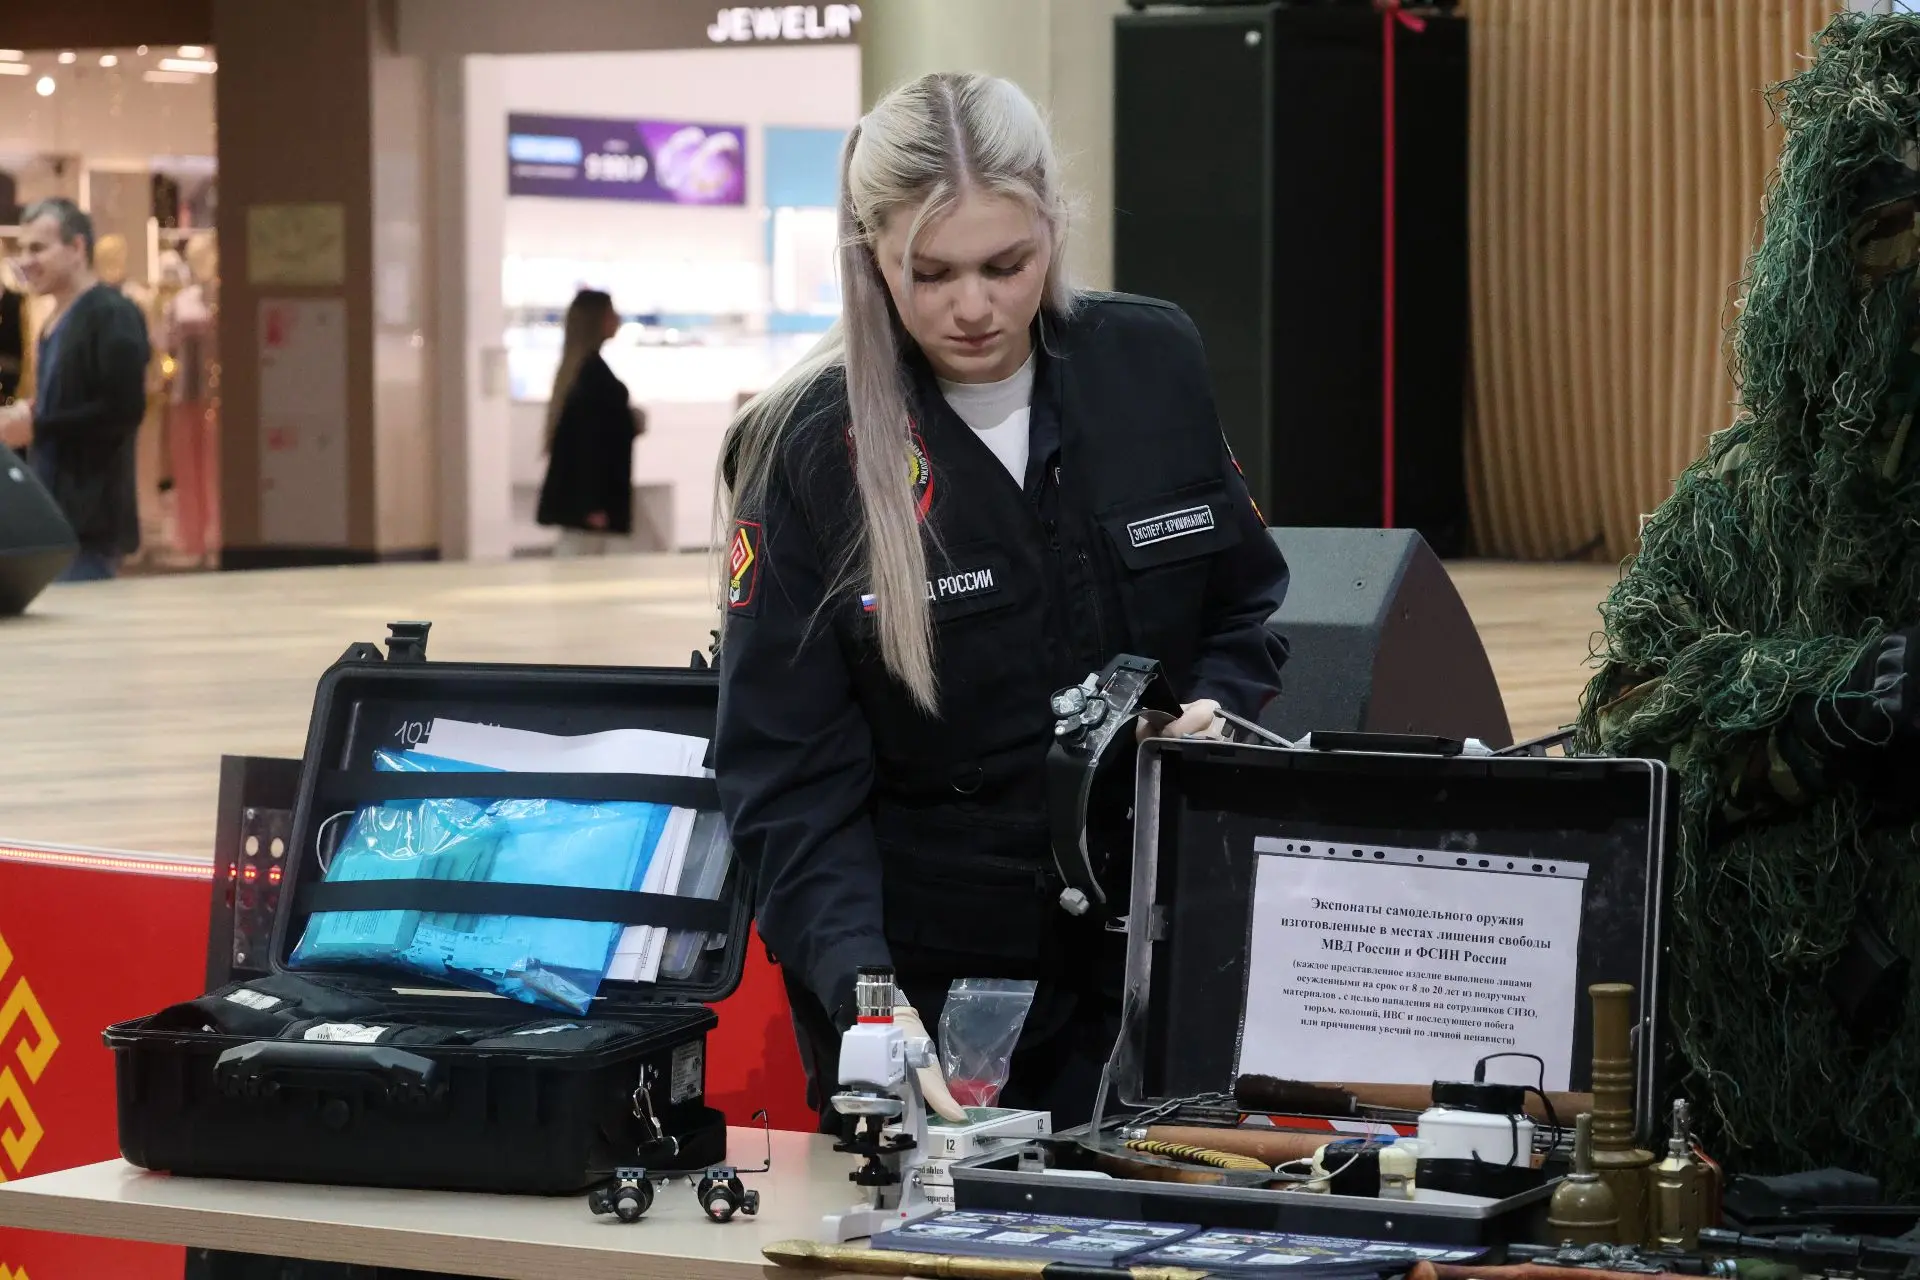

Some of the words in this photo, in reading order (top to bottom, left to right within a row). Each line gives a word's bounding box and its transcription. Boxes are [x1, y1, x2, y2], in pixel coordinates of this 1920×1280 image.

[1132, 511, 1211, 541] ЭКСПЕРТ-КРИМИНАЛИСТ
[937, 568, 994, 597] РОССИИ
[1310, 896, 1382, 915] Экспонаты
[1384, 905, 1473, 922] самодельного
[1475, 913, 1524, 927] оружия
[1280, 916, 1376, 934] изготовленные
[1378, 925, 1387, 935] в
[1389, 926, 1433, 939] местах
[1435, 930, 1495, 944] лишения
[1497, 934, 1551, 949] свободы
[1320, 937, 1353, 954] МВД
[1355, 940, 1401, 956] России
[1403, 947, 1412, 957] и
[1414, 945, 1460, 962] ФСИН
[1462, 949, 1507, 966] России
[1291, 958, 1329, 970] (каждое
[1330, 963, 1404, 977] представленное
[1404, 970, 1442, 980] изделие
[1443, 973, 1495, 985] выполнено
[1495, 978, 1532, 989] лицами
[1295, 974, 1360, 987] осужденными
[1361, 980, 1374, 989] на
[1374, 981, 1398, 992] срок
[1398, 983, 1409, 992] от
[1410, 982, 1418, 993] 8
[1418, 985, 1431, 994] до
[1431, 984, 1443, 995] 20
[1443, 987, 1460, 997] лет
[1461, 989, 1473, 998] из
[1473, 990, 1526, 1002] подручных
[1281, 987, 1336, 1000] материалов
[1349, 993, 1380, 1004] целью
[1381, 996, 1431, 1008] нападения
[1432, 1001, 1444, 1010] на
[1445, 1002, 1505, 1015] сотрудников
[1505, 1005, 1538, 1019] СИЗО,
[1299, 1017, 1318, 1026] или
[1319, 1019, 1377, 1032] причинения
[1377, 1025, 1411, 1035] увечий
[1412, 1028, 1425, 1037] по
[1425, 1029, 1461, 1040] личной
[1462, 1033, 1515, 1046] ненависти)
[1382, 1008, 1406, 1020] ИВС
[1406, 1013, 1414, 1021] и
[1414, 1014, 1482, 1028] последующего
[1483, 1019, 1514, 1031] побега
[1036, 1118, 1044, 1130] 12
[945, 1138, 956, 1151] 12
